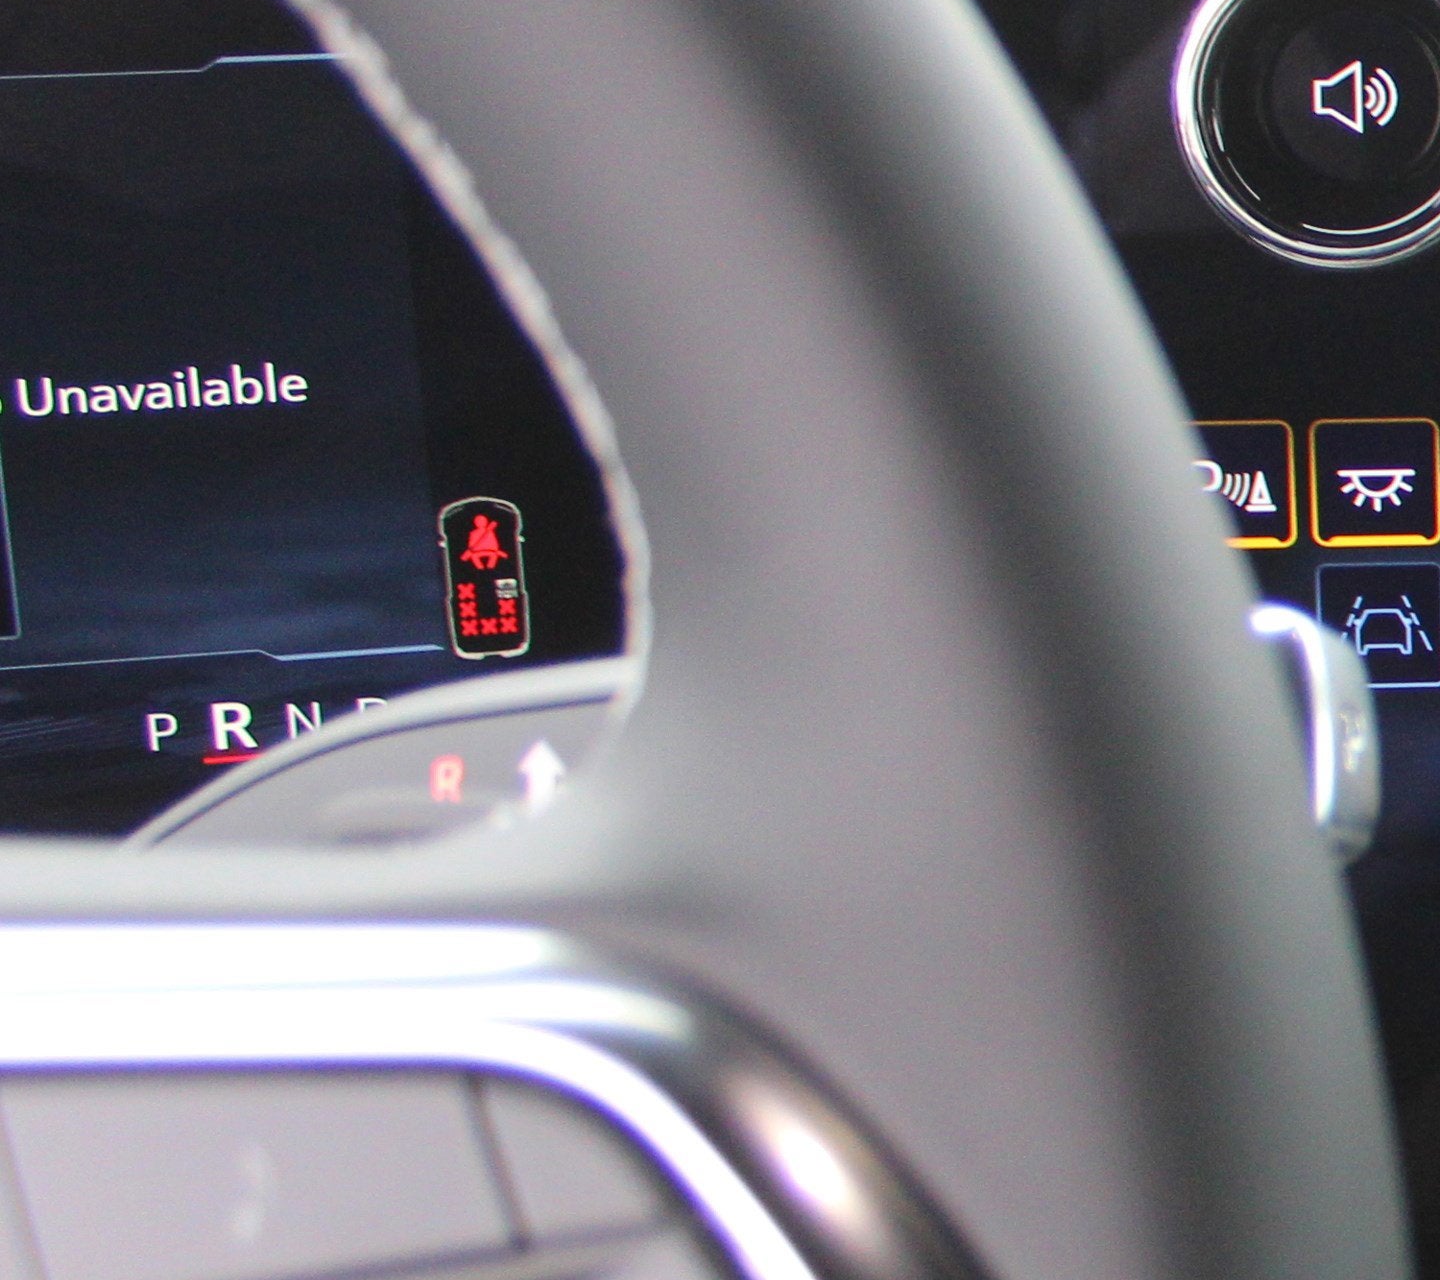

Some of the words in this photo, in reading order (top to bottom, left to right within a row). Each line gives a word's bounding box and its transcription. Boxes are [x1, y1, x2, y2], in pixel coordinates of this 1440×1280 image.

[15, 361, 308, 418] Unavailable
[146, 712, 178, 752] P
[211, 700, 259, 750] R
[285, 700, 324, 739] N
